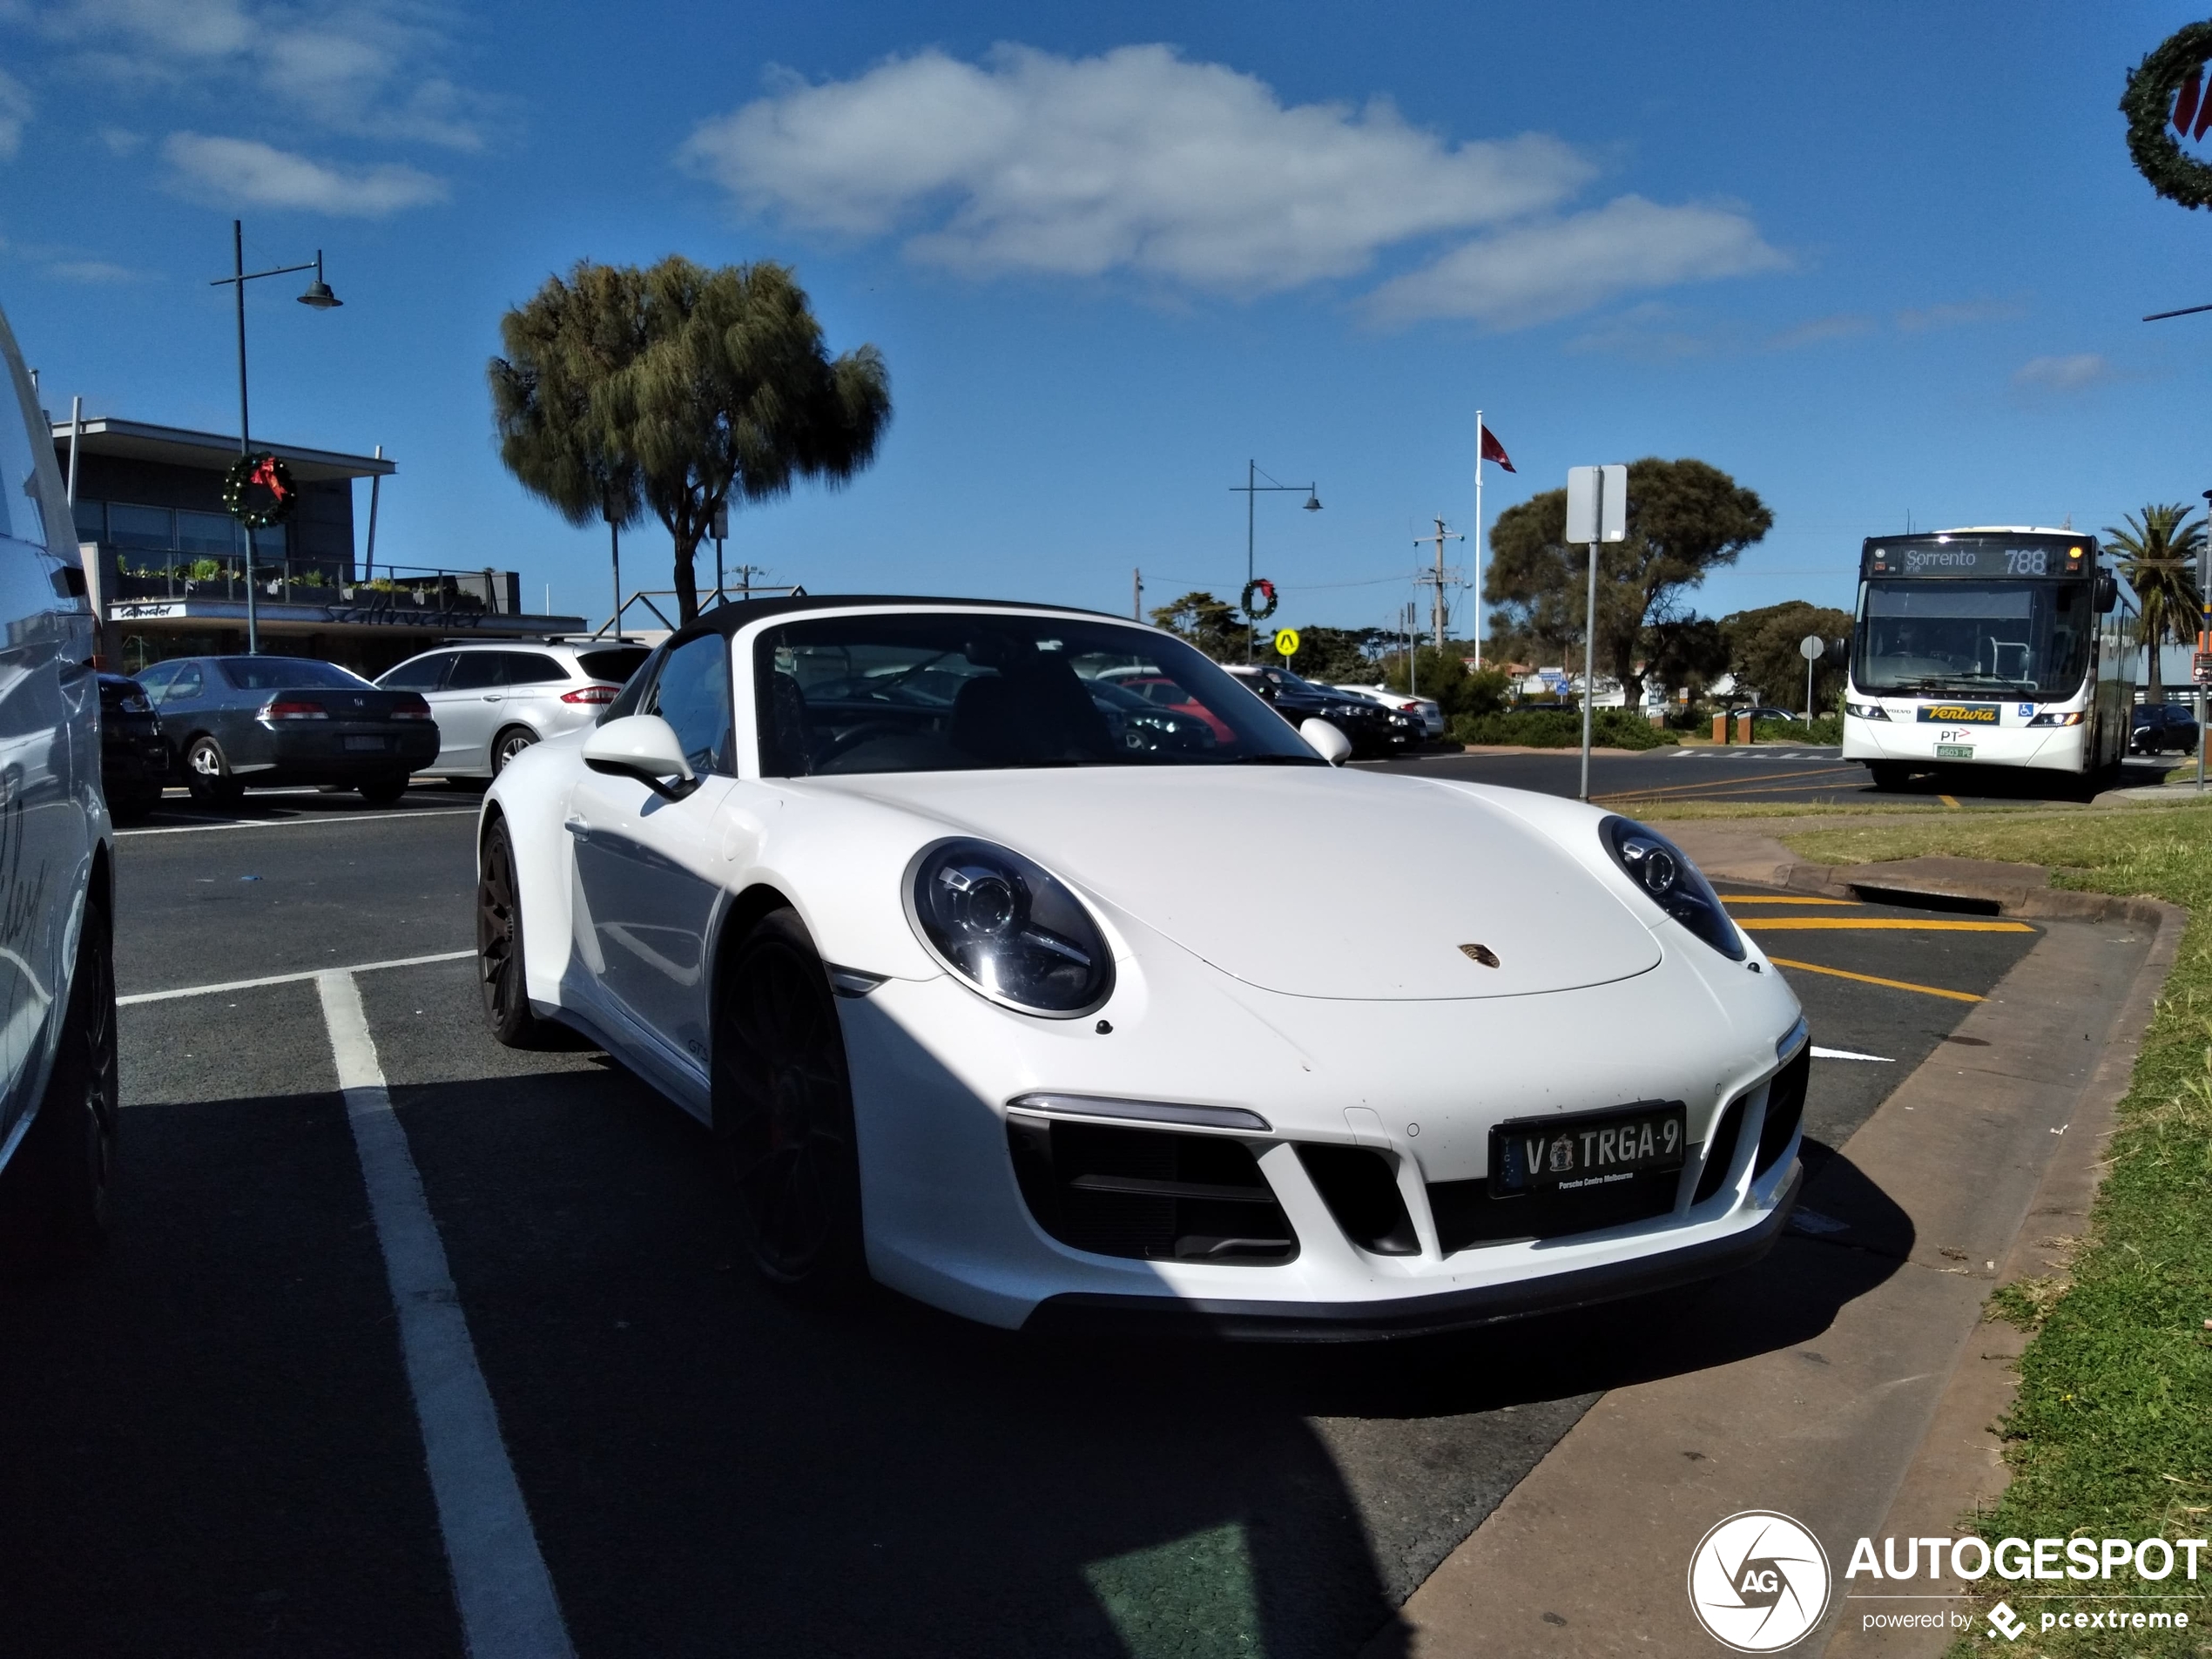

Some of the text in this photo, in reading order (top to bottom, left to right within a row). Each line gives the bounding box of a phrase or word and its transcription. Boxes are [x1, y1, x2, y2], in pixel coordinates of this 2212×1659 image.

[1906, 549, 2047, 576] Sorrento 788
[1923, 705, 1996, 721] Ventura
[1559, 1172, 1634, 1190] Porsche Centre Melbourne
